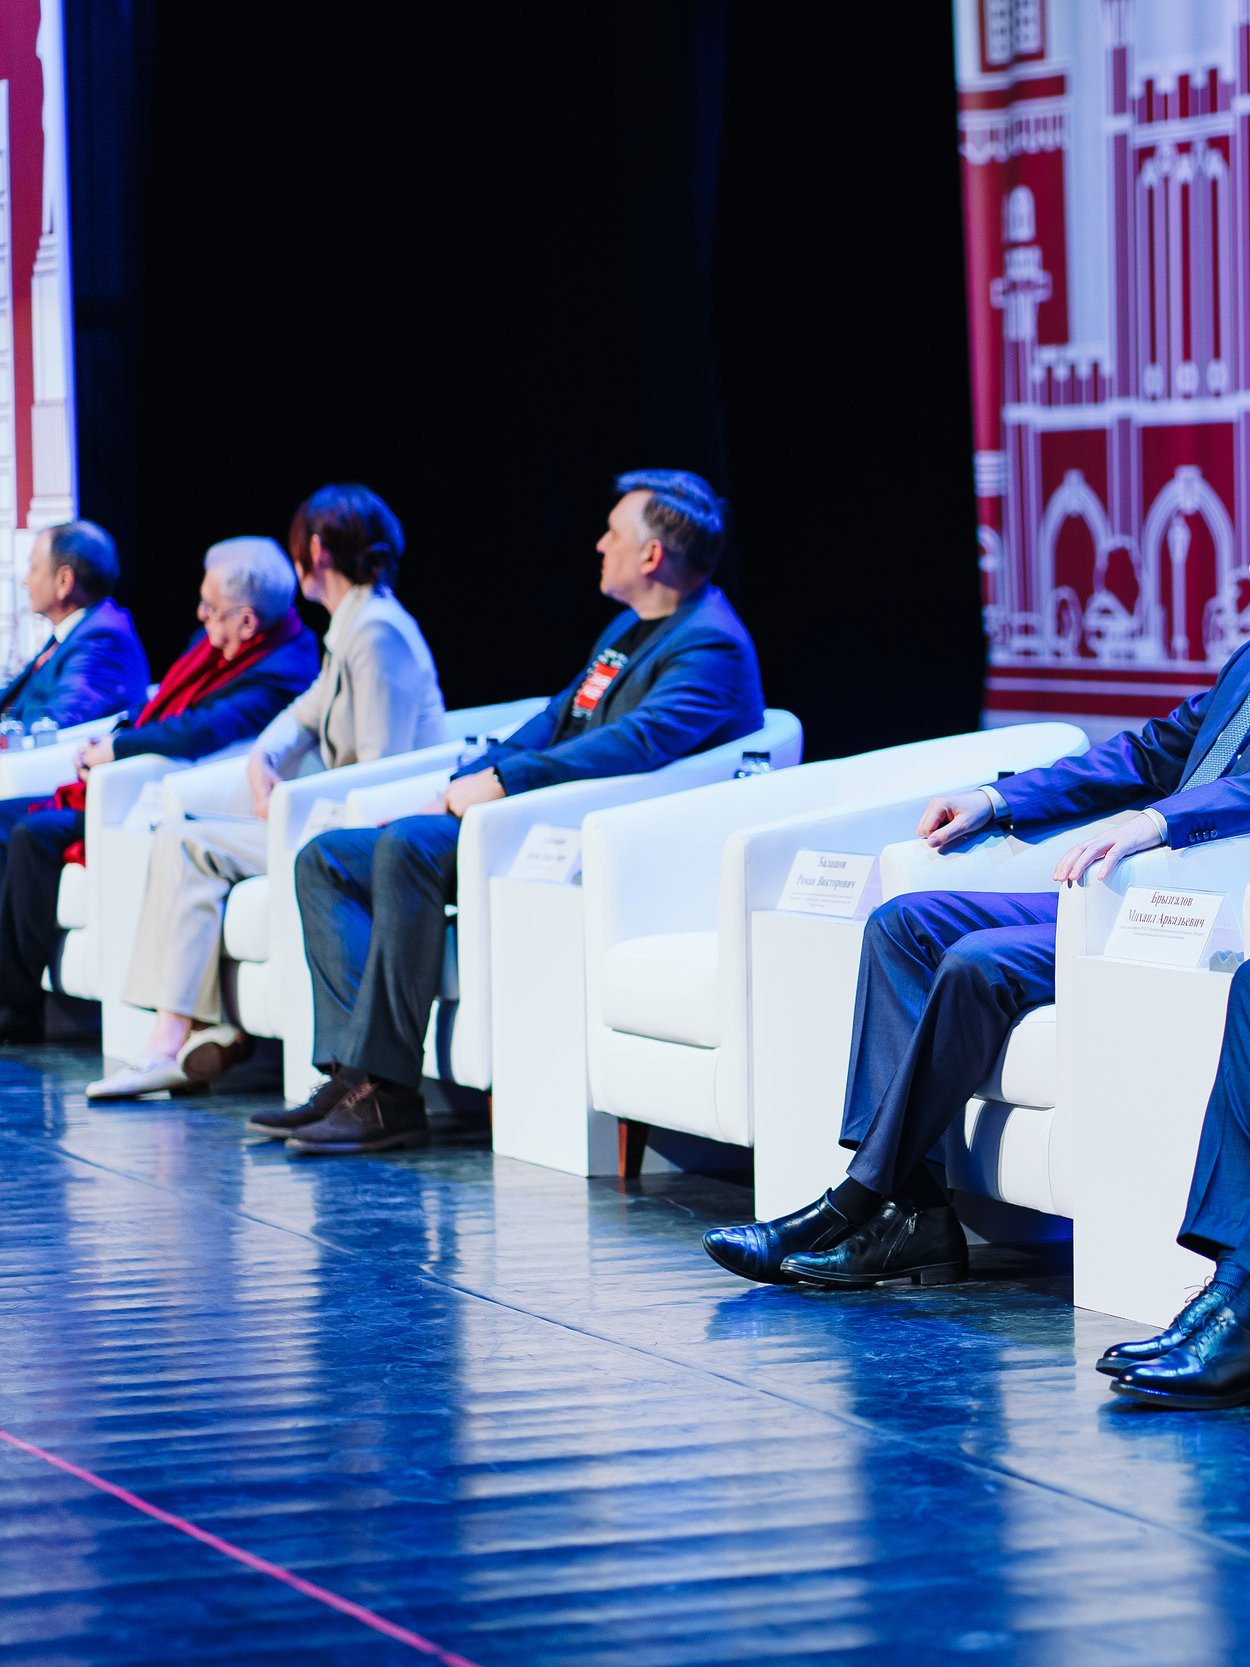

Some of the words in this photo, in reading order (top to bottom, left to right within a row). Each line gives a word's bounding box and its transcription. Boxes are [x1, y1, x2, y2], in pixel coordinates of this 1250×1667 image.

[1150, 891, 1194, 907] Брызгалов
[1127, 909, 1158, 923] Михаил
[1157, 912, 1206, 928] Аркадьевич
